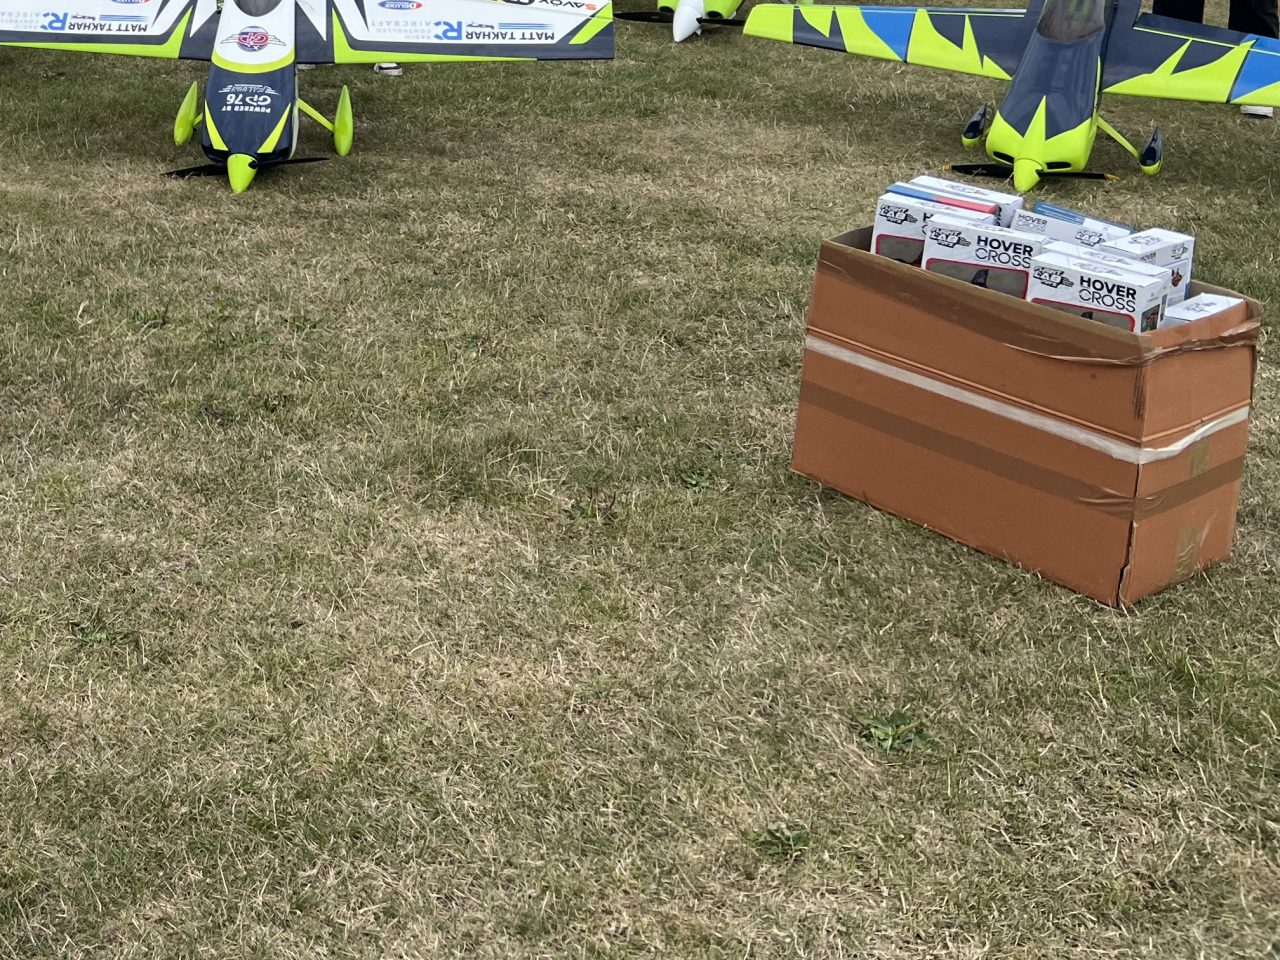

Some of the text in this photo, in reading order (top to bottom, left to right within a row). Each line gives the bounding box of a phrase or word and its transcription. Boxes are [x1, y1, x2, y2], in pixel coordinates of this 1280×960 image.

[68, 21, 148, 32] MATT TAKHAR
[465, 30, 555, 40] MATT TAKHAR
[226, 94, 243, 105] 76
[234, 106, 271, 114] POWERED
[879, 209, 906, 222] LAB
[1017, 213, 1048, 226] HOVER
[929, 232, 959, 246] LAB
[977, 235, 1033, 257] HOVER
[975, 248, 1031, 269] CROSS
[1032, 270, 1062, 286] LAB
[1079, 275, 1137, 301] HOVER
[1078, 289, 1136, 314] CROSS
